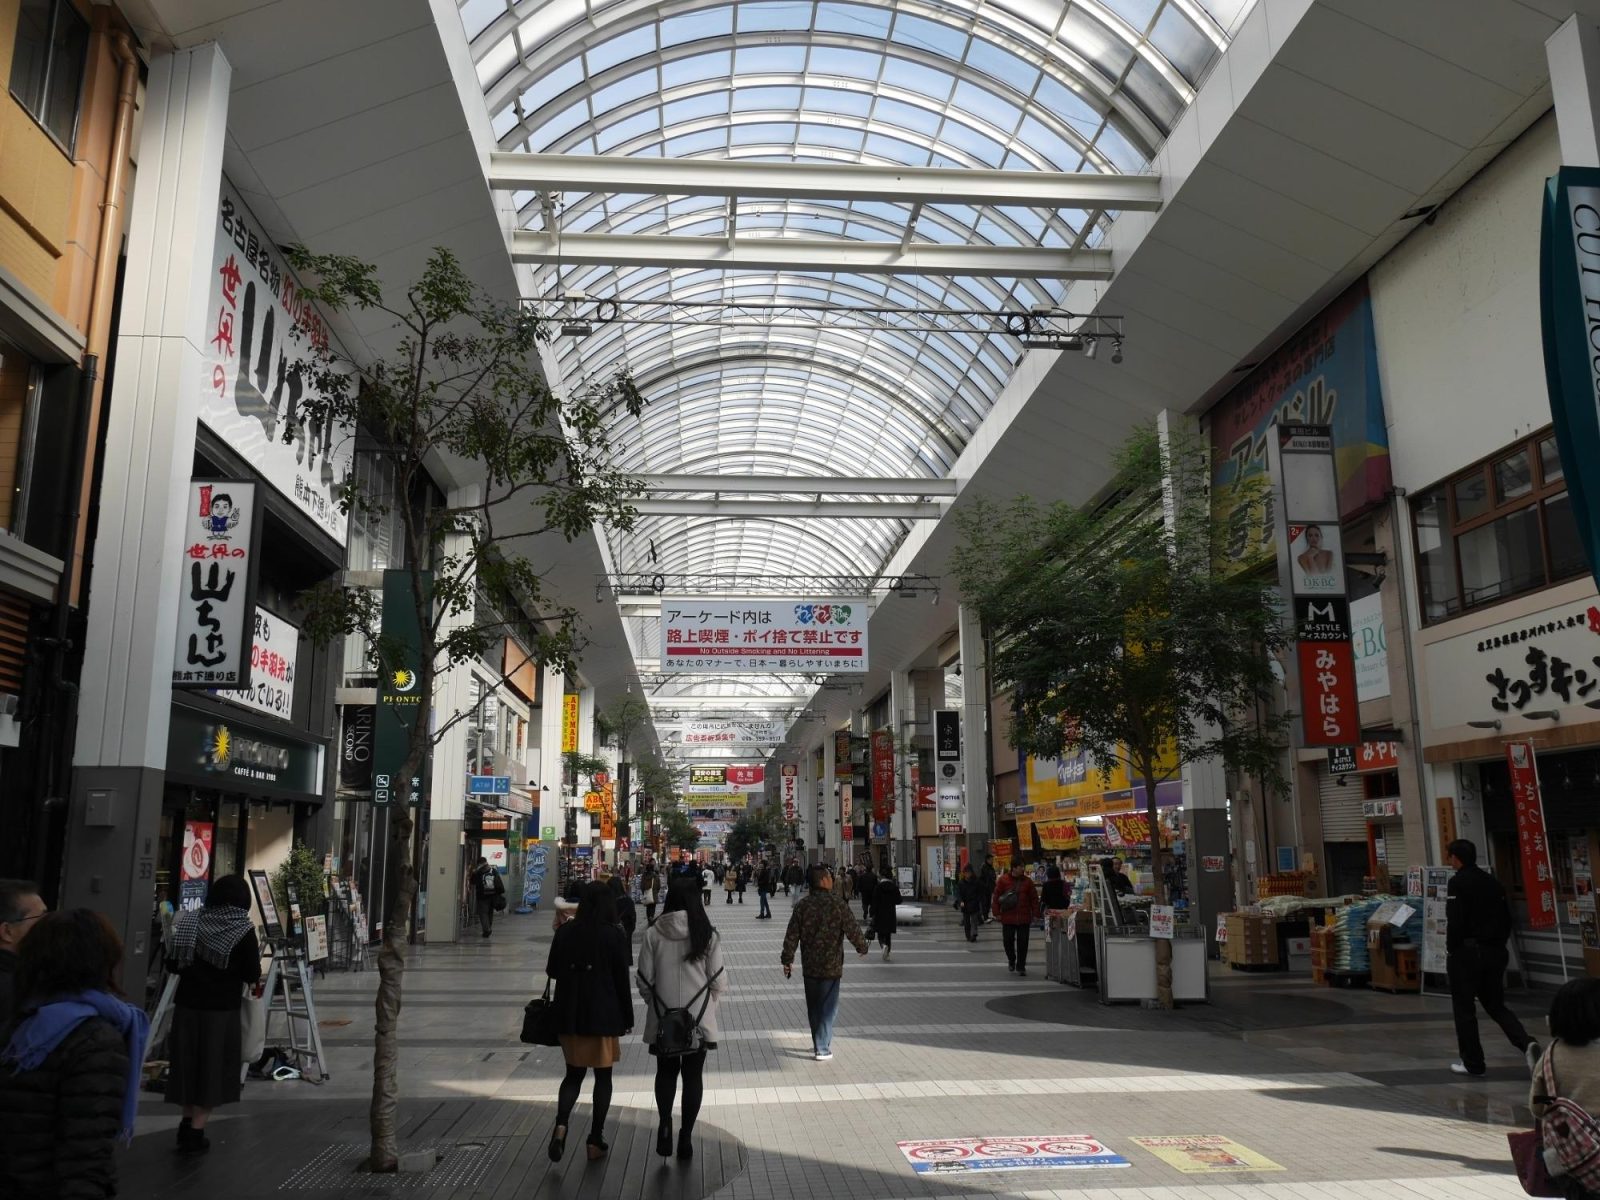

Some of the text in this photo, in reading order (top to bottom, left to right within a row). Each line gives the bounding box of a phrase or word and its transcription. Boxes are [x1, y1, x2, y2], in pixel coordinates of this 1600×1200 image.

[221, 195, 280, 299] 名古屋名物
[211, 254, 242, 398] 世界の
[294, 474, 337, 531] 熊本下通り店
[186, 543, 245, 559] 世界の
[187, 561, 235, 667] 山ちゃん
[667, 610, 772, 624] アーケード内は
[1299, 631, 1348, 640] ディスカウント
[1305, 623, 1341, 632] M-STYLE
[667, 629, 863, 644] 路上喫煙・ポイ捨て禁止です
[740, 648, 772, 656] Smoking
[800, 648, 830, 656] Littering
[173, 670, 236, 682] 熊本下通り店
[1315, 649, 1341, 737] みやはら
[345, 723, 355, 761] SECOND
